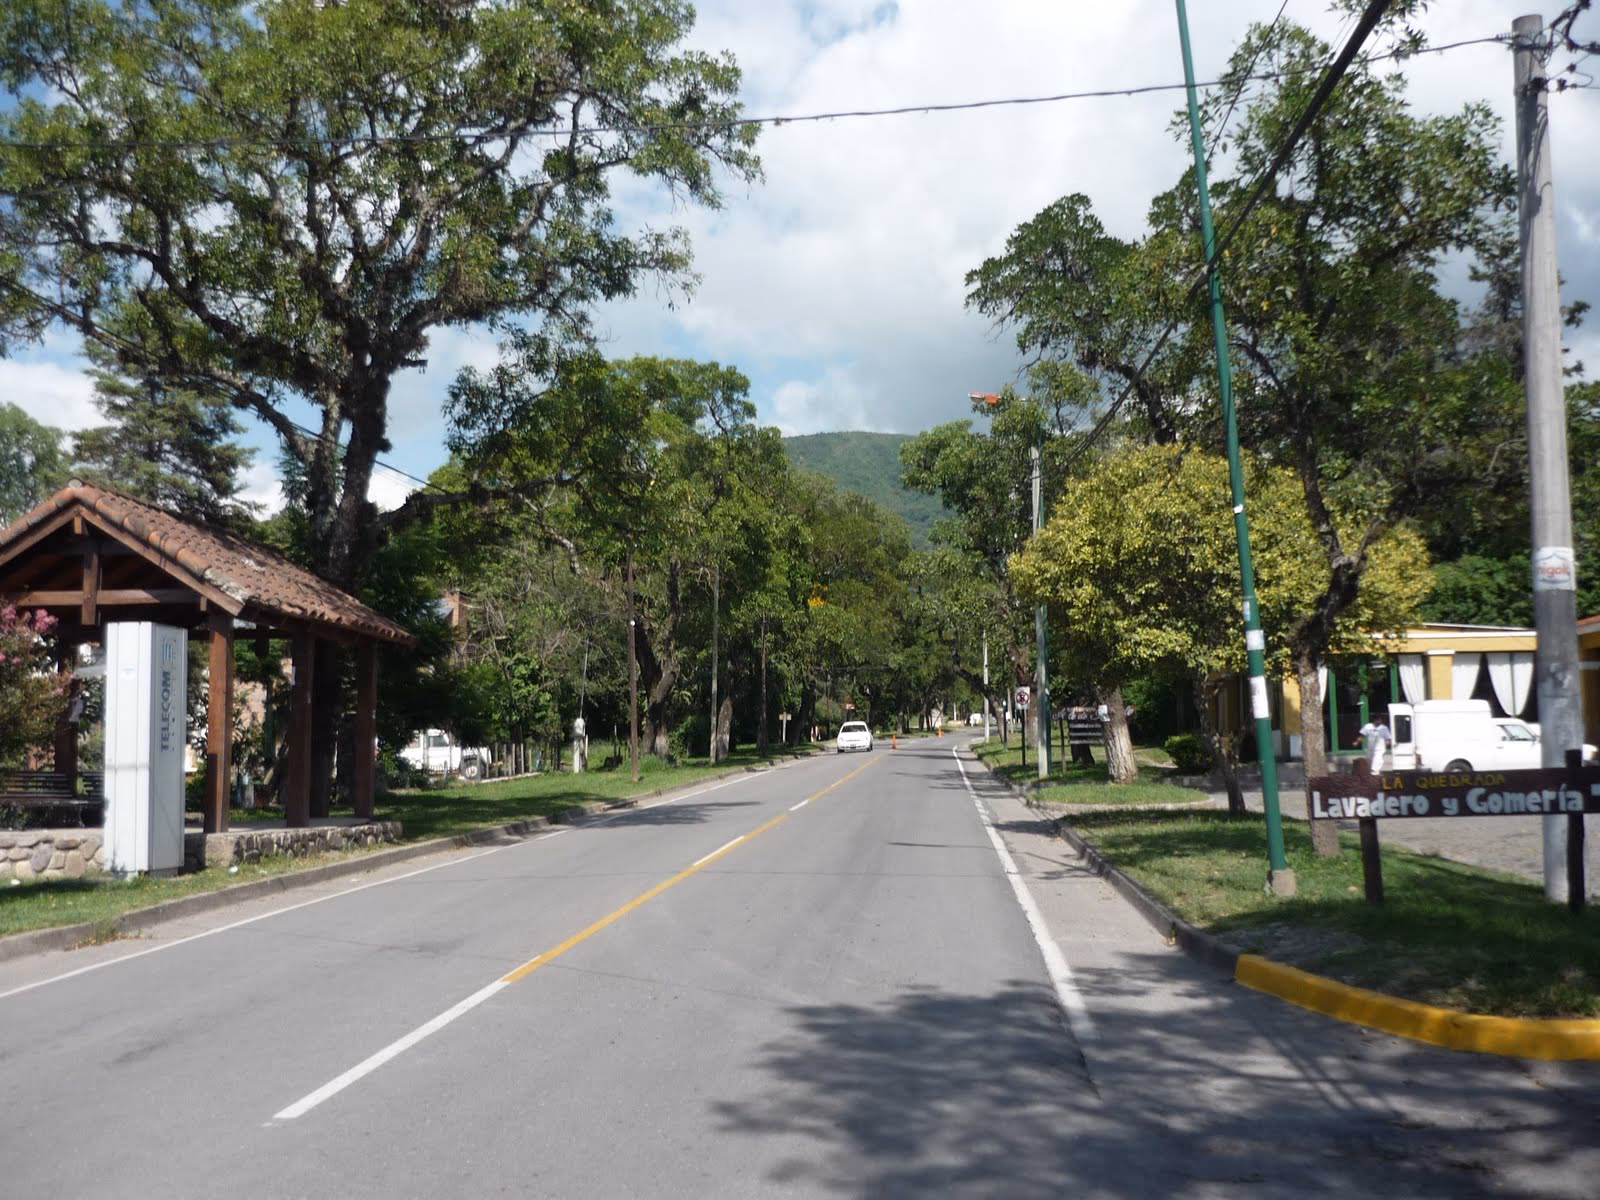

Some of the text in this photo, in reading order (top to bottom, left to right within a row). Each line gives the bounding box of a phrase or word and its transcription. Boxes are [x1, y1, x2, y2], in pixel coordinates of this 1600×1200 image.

[161, 671, 171, 752] TELECOM
[1381, 774, 1506, 790] LA QUEBRADA
[1312, 791, 1429, 818] Lavadero
[1441, 797, 1460, 816] y
[1466, 783, 1584, 814] Gomería
